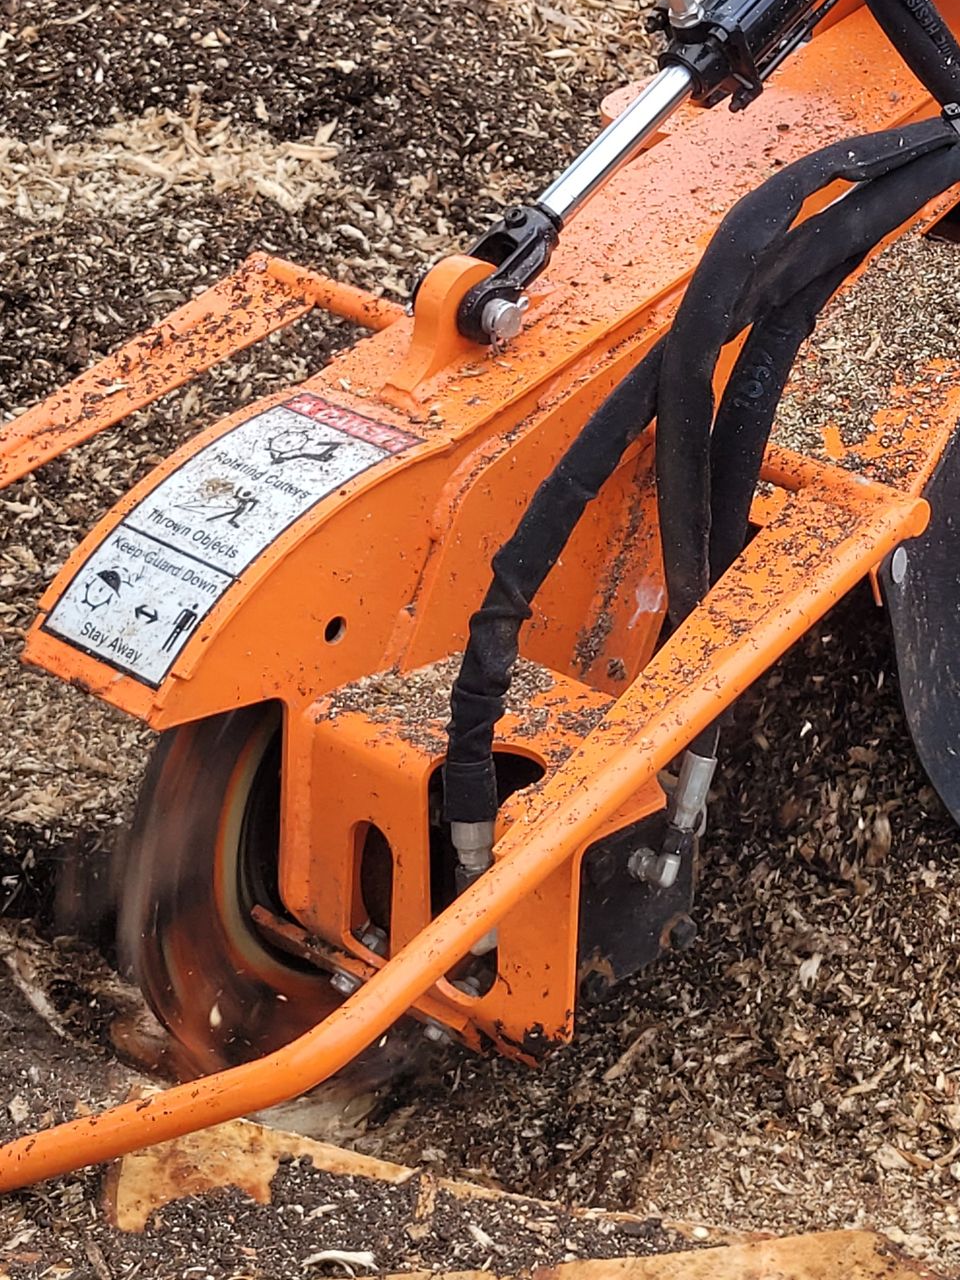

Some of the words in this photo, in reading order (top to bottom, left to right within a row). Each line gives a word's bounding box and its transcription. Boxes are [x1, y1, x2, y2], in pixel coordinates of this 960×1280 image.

[264, 472, 313, 500] Cutters
[147, 507, 192, 537] Thrown
[192, 529, 240, 560] Objects
[111, 535, 144, 559] Keep
[144, 550, 180, 577] Guard
[80, 621, 109, 648] Stay
[107, 636, 143, 665] Away
